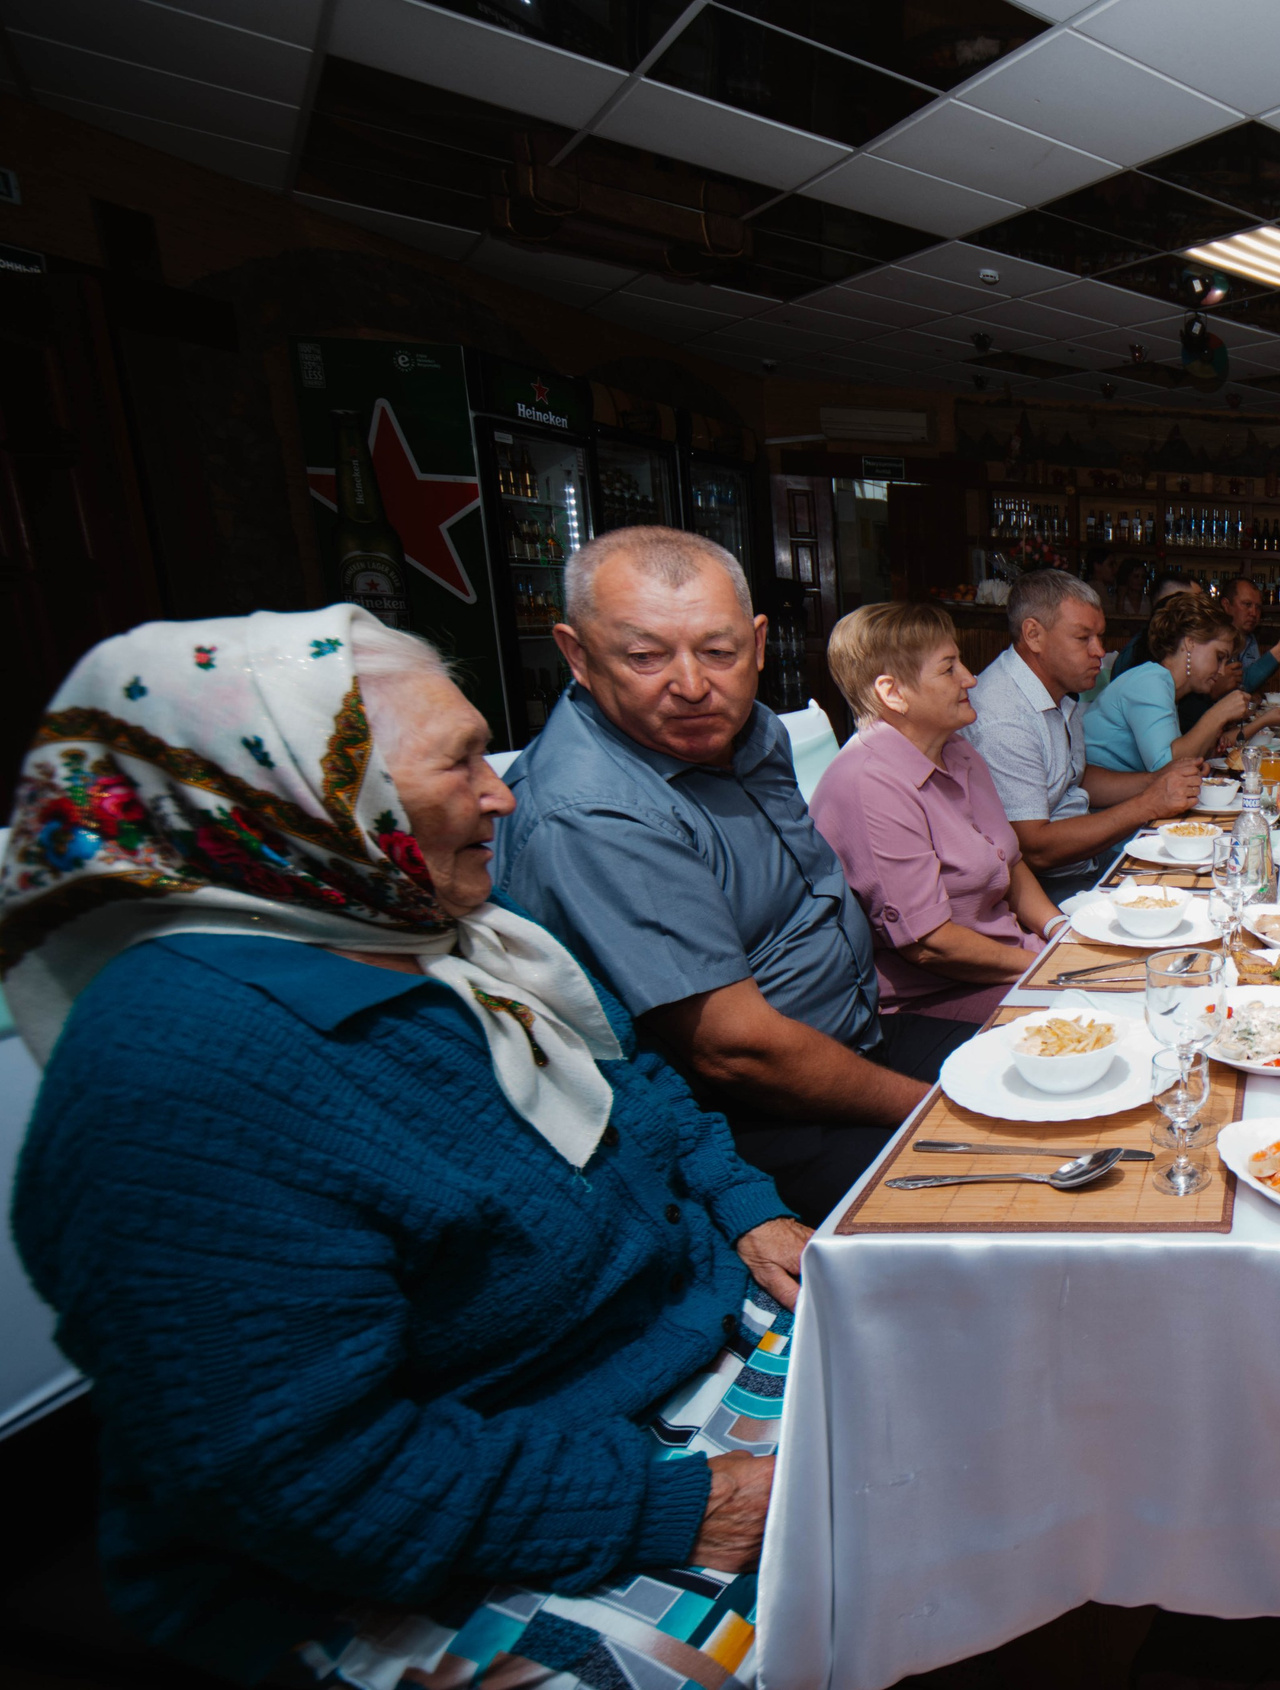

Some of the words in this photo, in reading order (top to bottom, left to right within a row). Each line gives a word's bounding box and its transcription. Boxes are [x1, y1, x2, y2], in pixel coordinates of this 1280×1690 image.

[304, 369, 323, 380] LESS
[517, 402, 568, 428] Heineken
[352, 459, 365, 505] Heineken
[367, 560, 389, 575] LAGER
